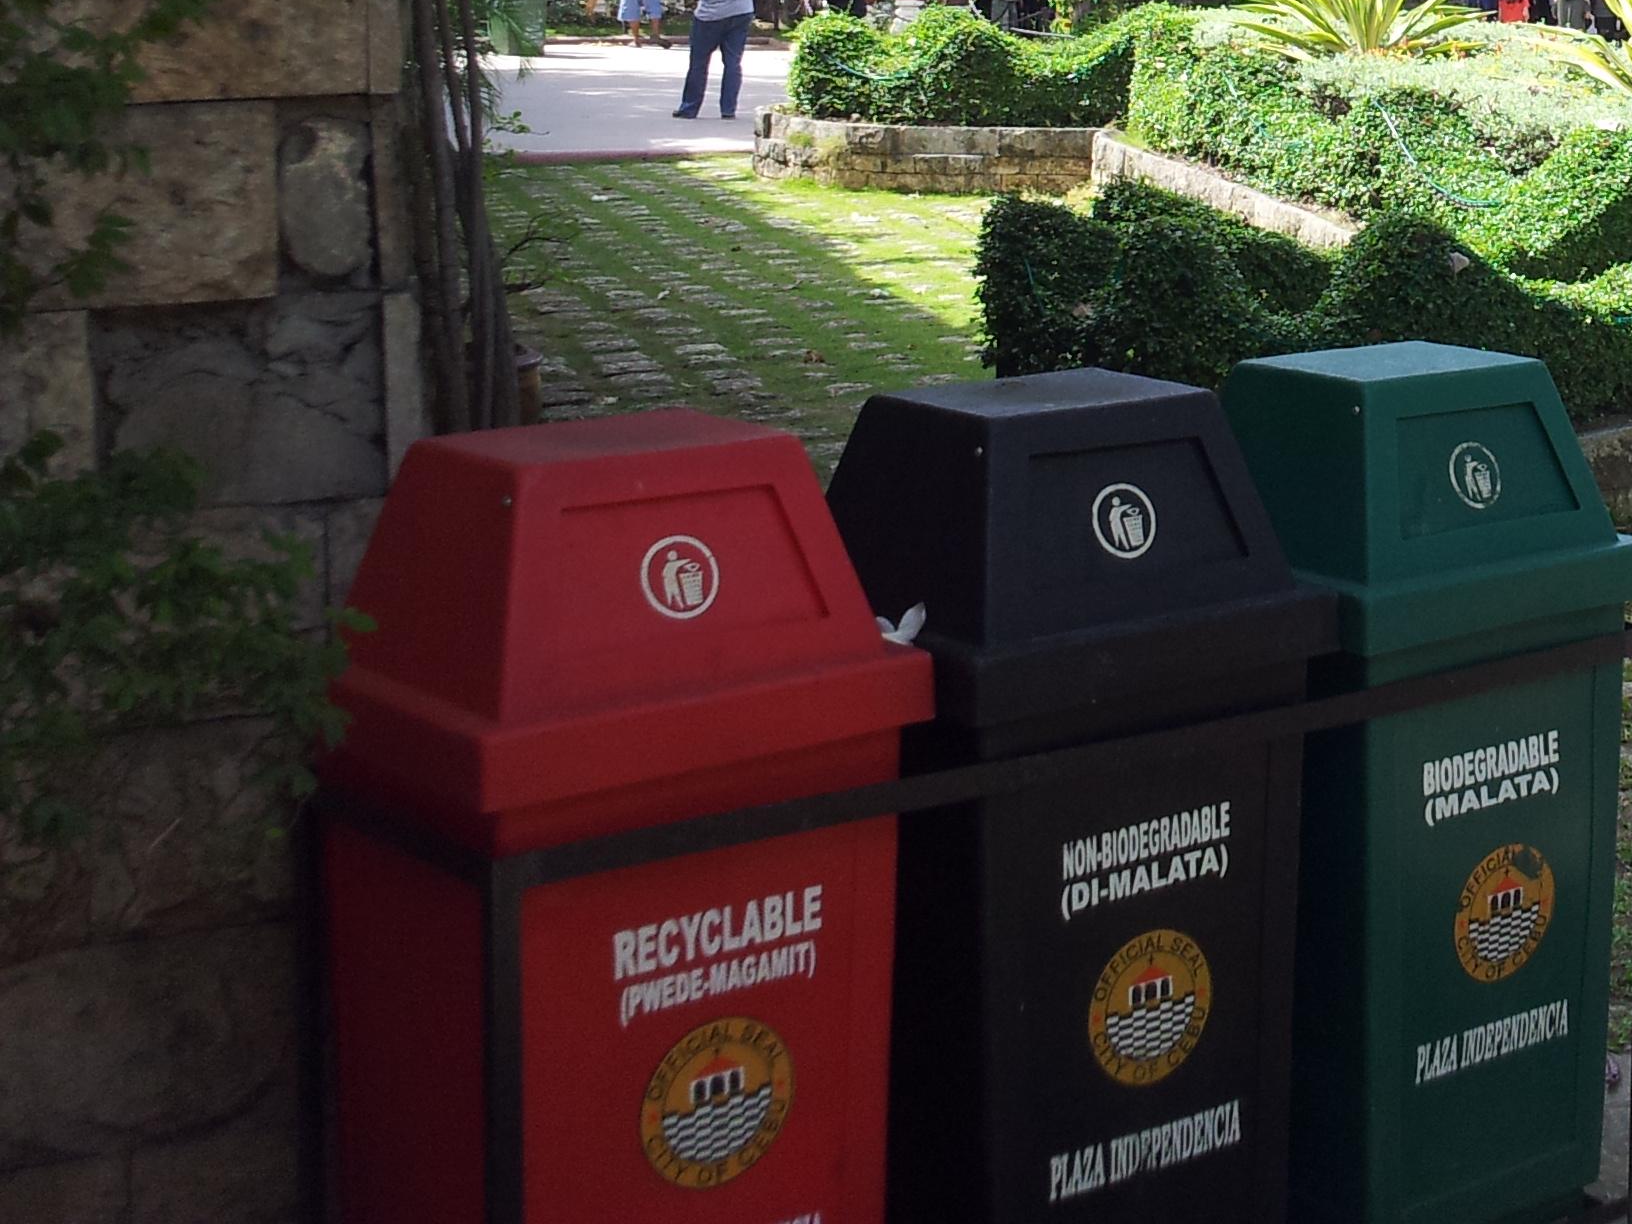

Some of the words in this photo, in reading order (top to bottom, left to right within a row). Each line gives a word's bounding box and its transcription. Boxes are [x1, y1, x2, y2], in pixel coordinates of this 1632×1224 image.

[1423, 730, 1559, 797] BIODEGRADABLE
[1424, 767, 1559, 827] (MALATA)
[1062, 801, 1230, 880] NON-BIODEGRADABLE
[1061, 843, 1229, 921] (DI-MALATA)
[613, 884, 823, 981] RECYCLABLE
[1093, 933, 1165, 1002] OFFICIAL
[1170, 936, 1205, 978] SEAL
[1457, 936, 1483, 973] CITY
[1485, 964, 1505, 980] OF
[1512, 914, 1547, 966] CEBU
[620, 939, 816, 1028] (PWEDE-MAGAMIT)
[647, 1022, 732, 1101] OFFICIAL
[742, 1023, 784, 1062] SEAL
[1093, 1031, 1129, 1076] CITY
[1133, 1060, 1159, 1080] OF
[1167, 1007, 1206, 1067] CEBU
[1415, 1034, 1458, 1085] PLAZA
[1460, 998, 1569, 1068] INDEPENDENCIA
[646, 1136, 690, 1181] CITY
[697, 1162, 729, 1184] OF
[738, 1098, 786, 1166] CEBU
[1049, 1142, 1106, 1203] PLAZA
[1109, 1098, 1241, 1183] INDEPENDENCIA
